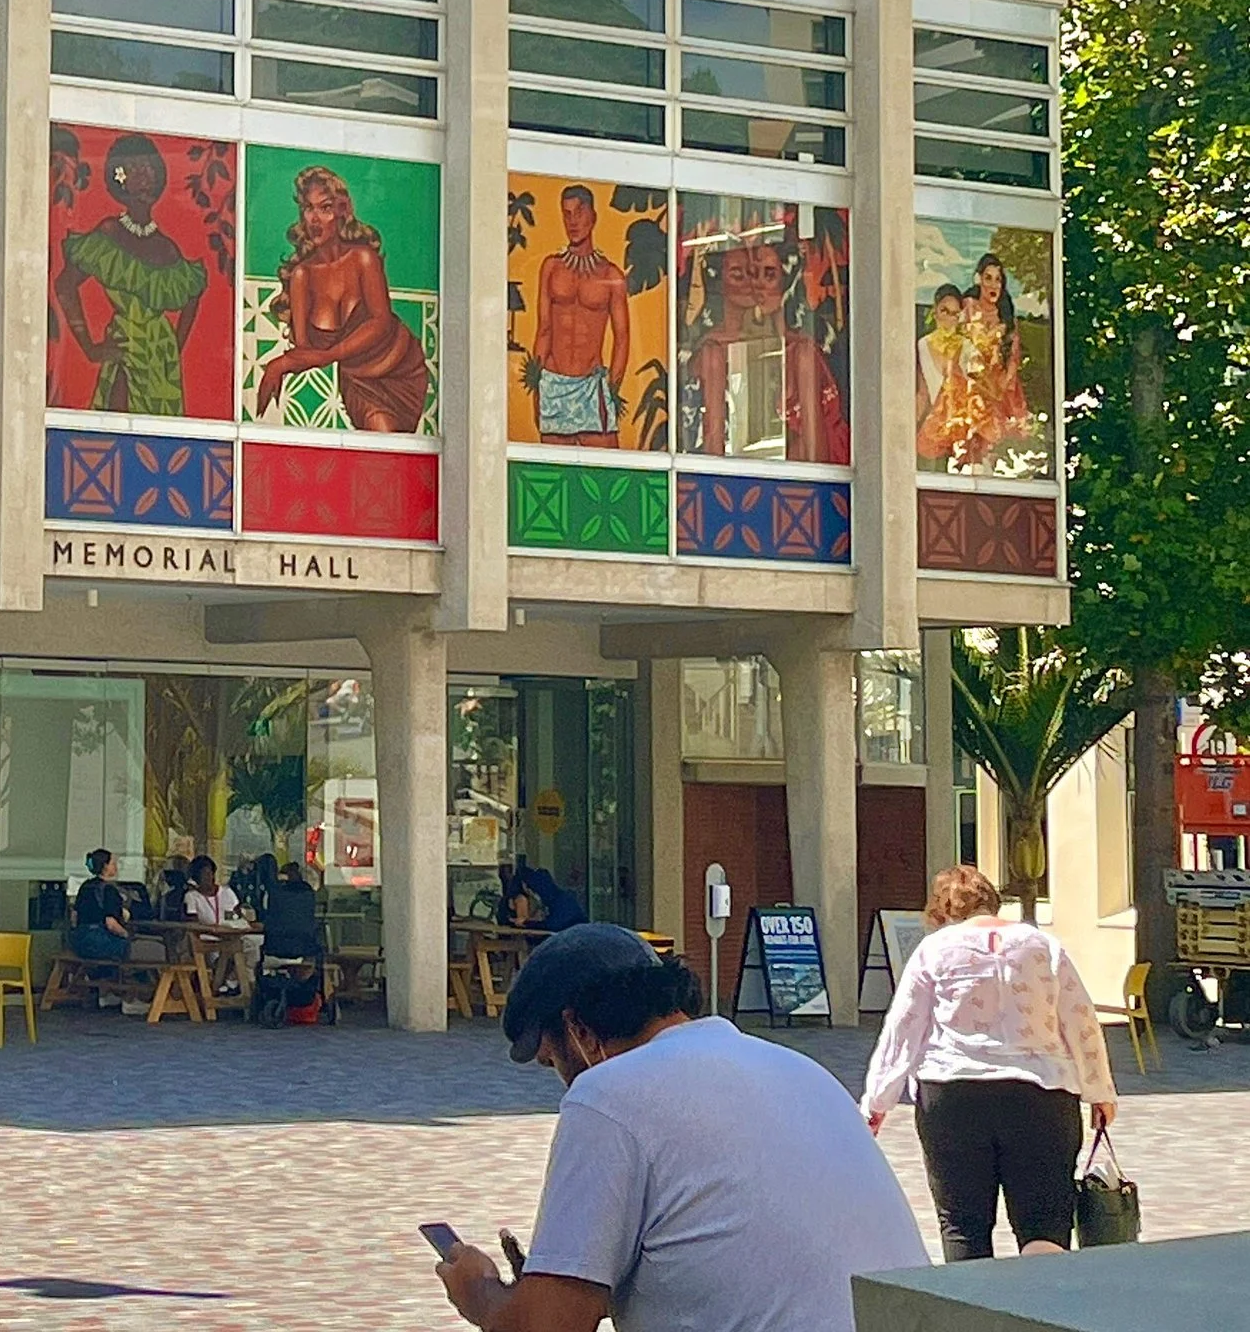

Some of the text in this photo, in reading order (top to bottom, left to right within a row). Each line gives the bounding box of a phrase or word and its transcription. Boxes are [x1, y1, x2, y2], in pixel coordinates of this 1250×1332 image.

[53, 540, 236, 573] MEMORIAL
[279, 553, 359, 579] HALL
[761, 916, 813, 934] OVER 150
